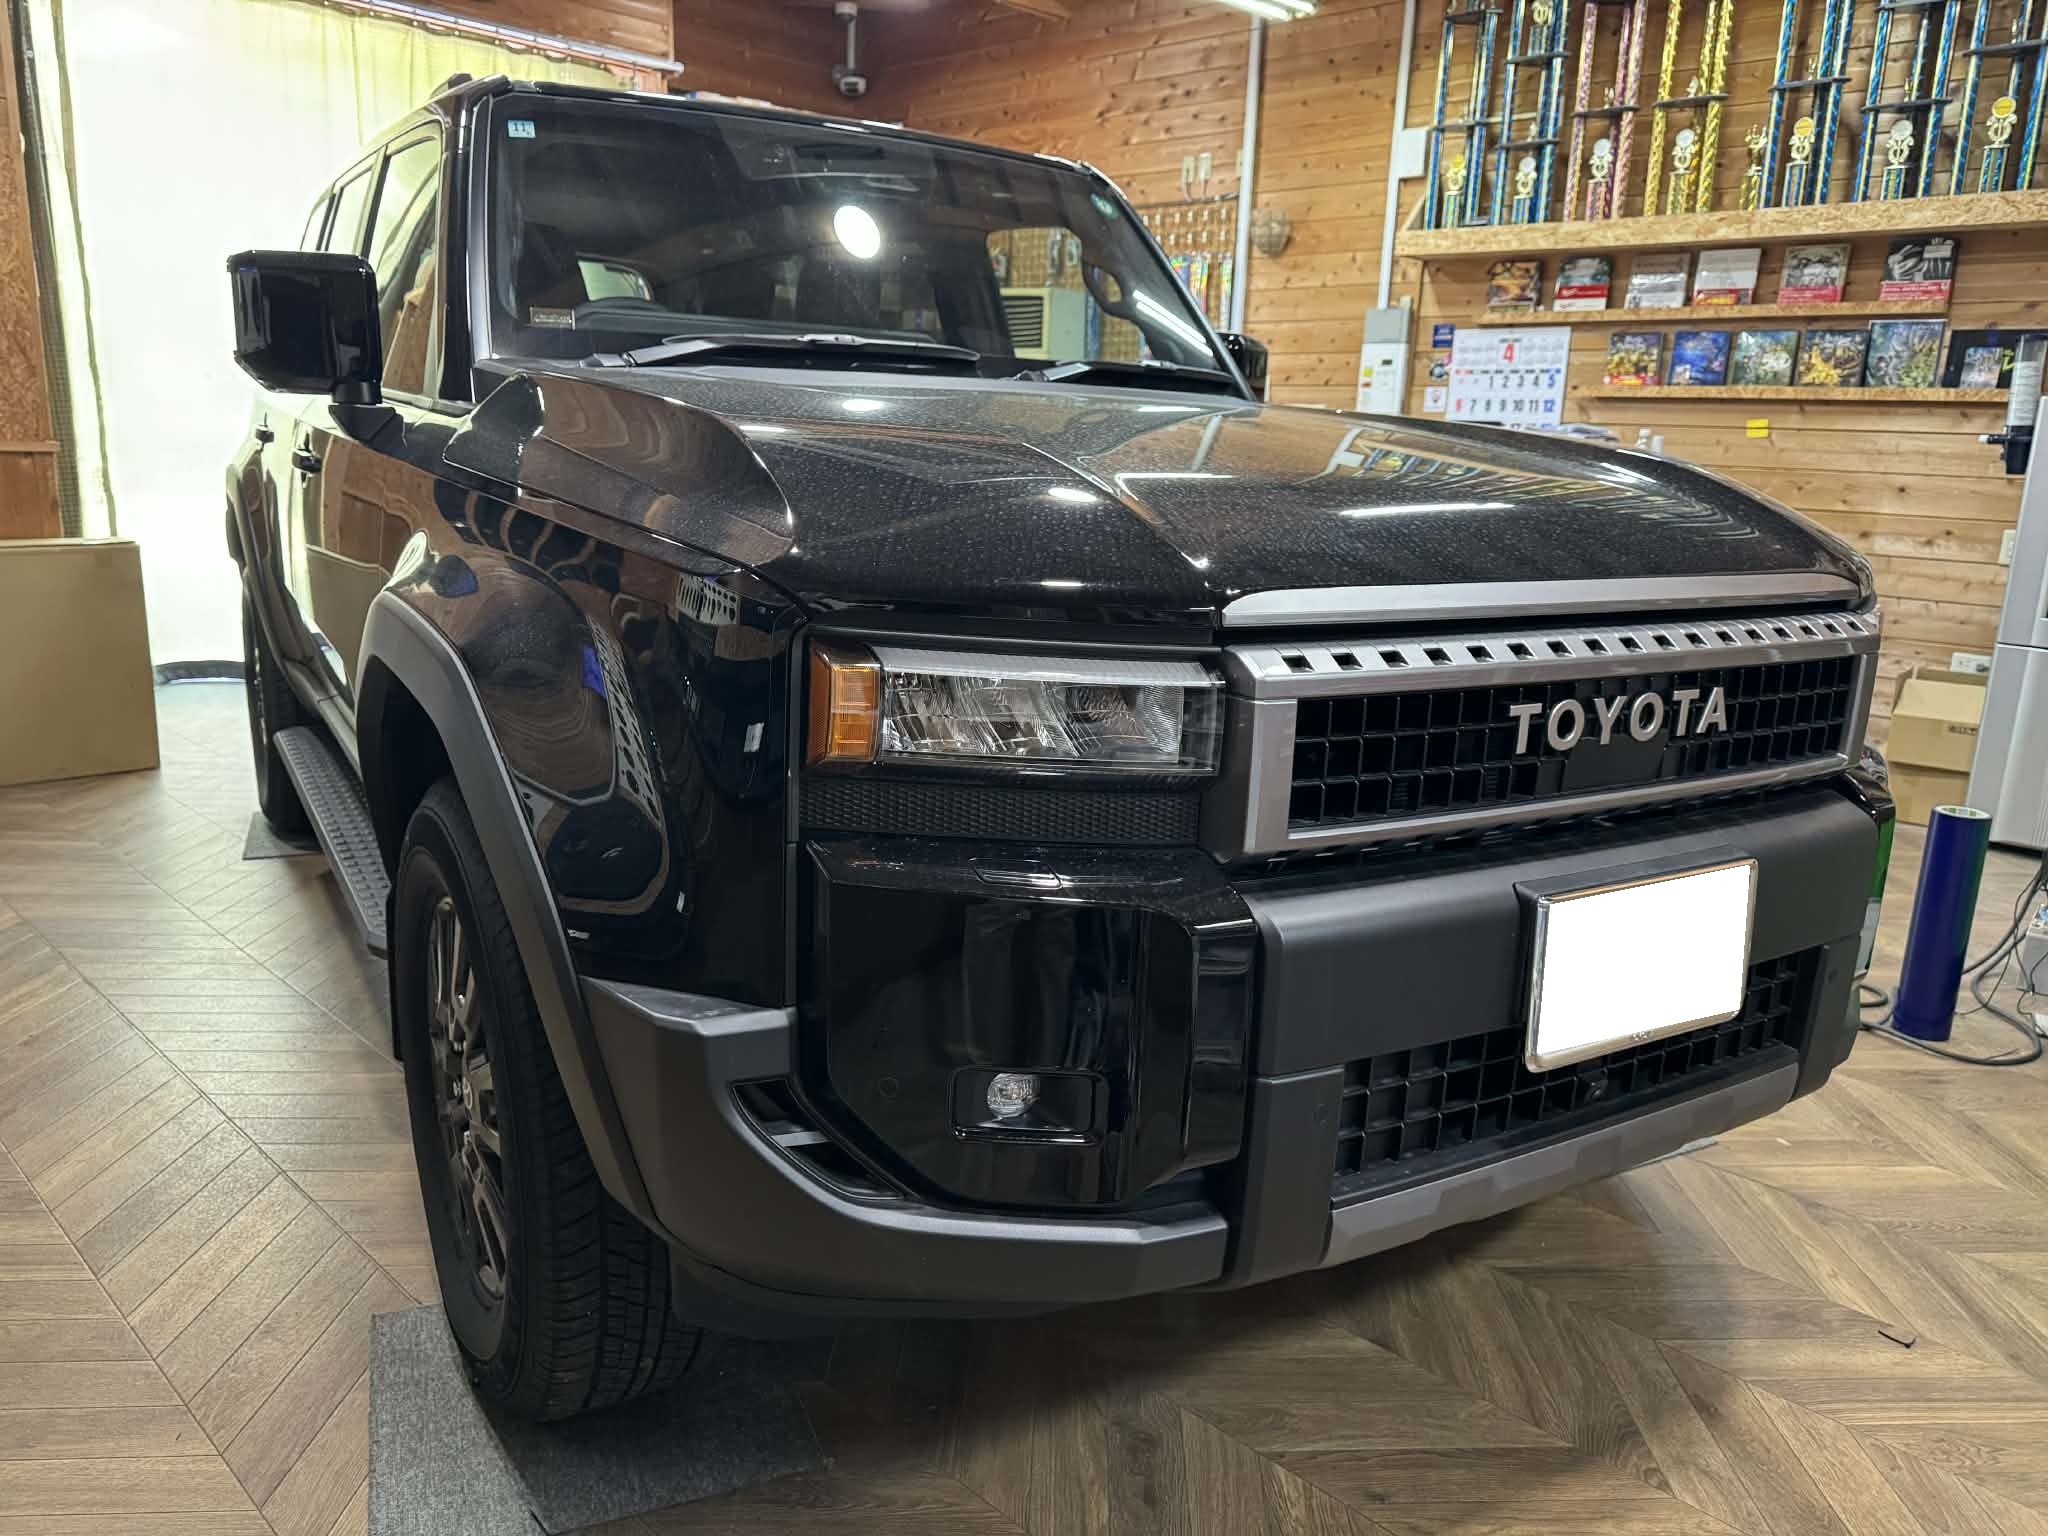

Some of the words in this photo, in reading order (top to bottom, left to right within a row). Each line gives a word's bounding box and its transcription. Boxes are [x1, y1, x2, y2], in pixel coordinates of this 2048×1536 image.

[1503, 343, 1515, 363] 4
[1501, 375, 1510, 389] 2
[1517, 375, 1525, 388] 3
[1532, 375, 1540, 387] 4
[1547, 374, 1556, 389] 5
[1543, 399, 1555, 413] 12
[1509, 686, 1728, 755] TOYOTA
